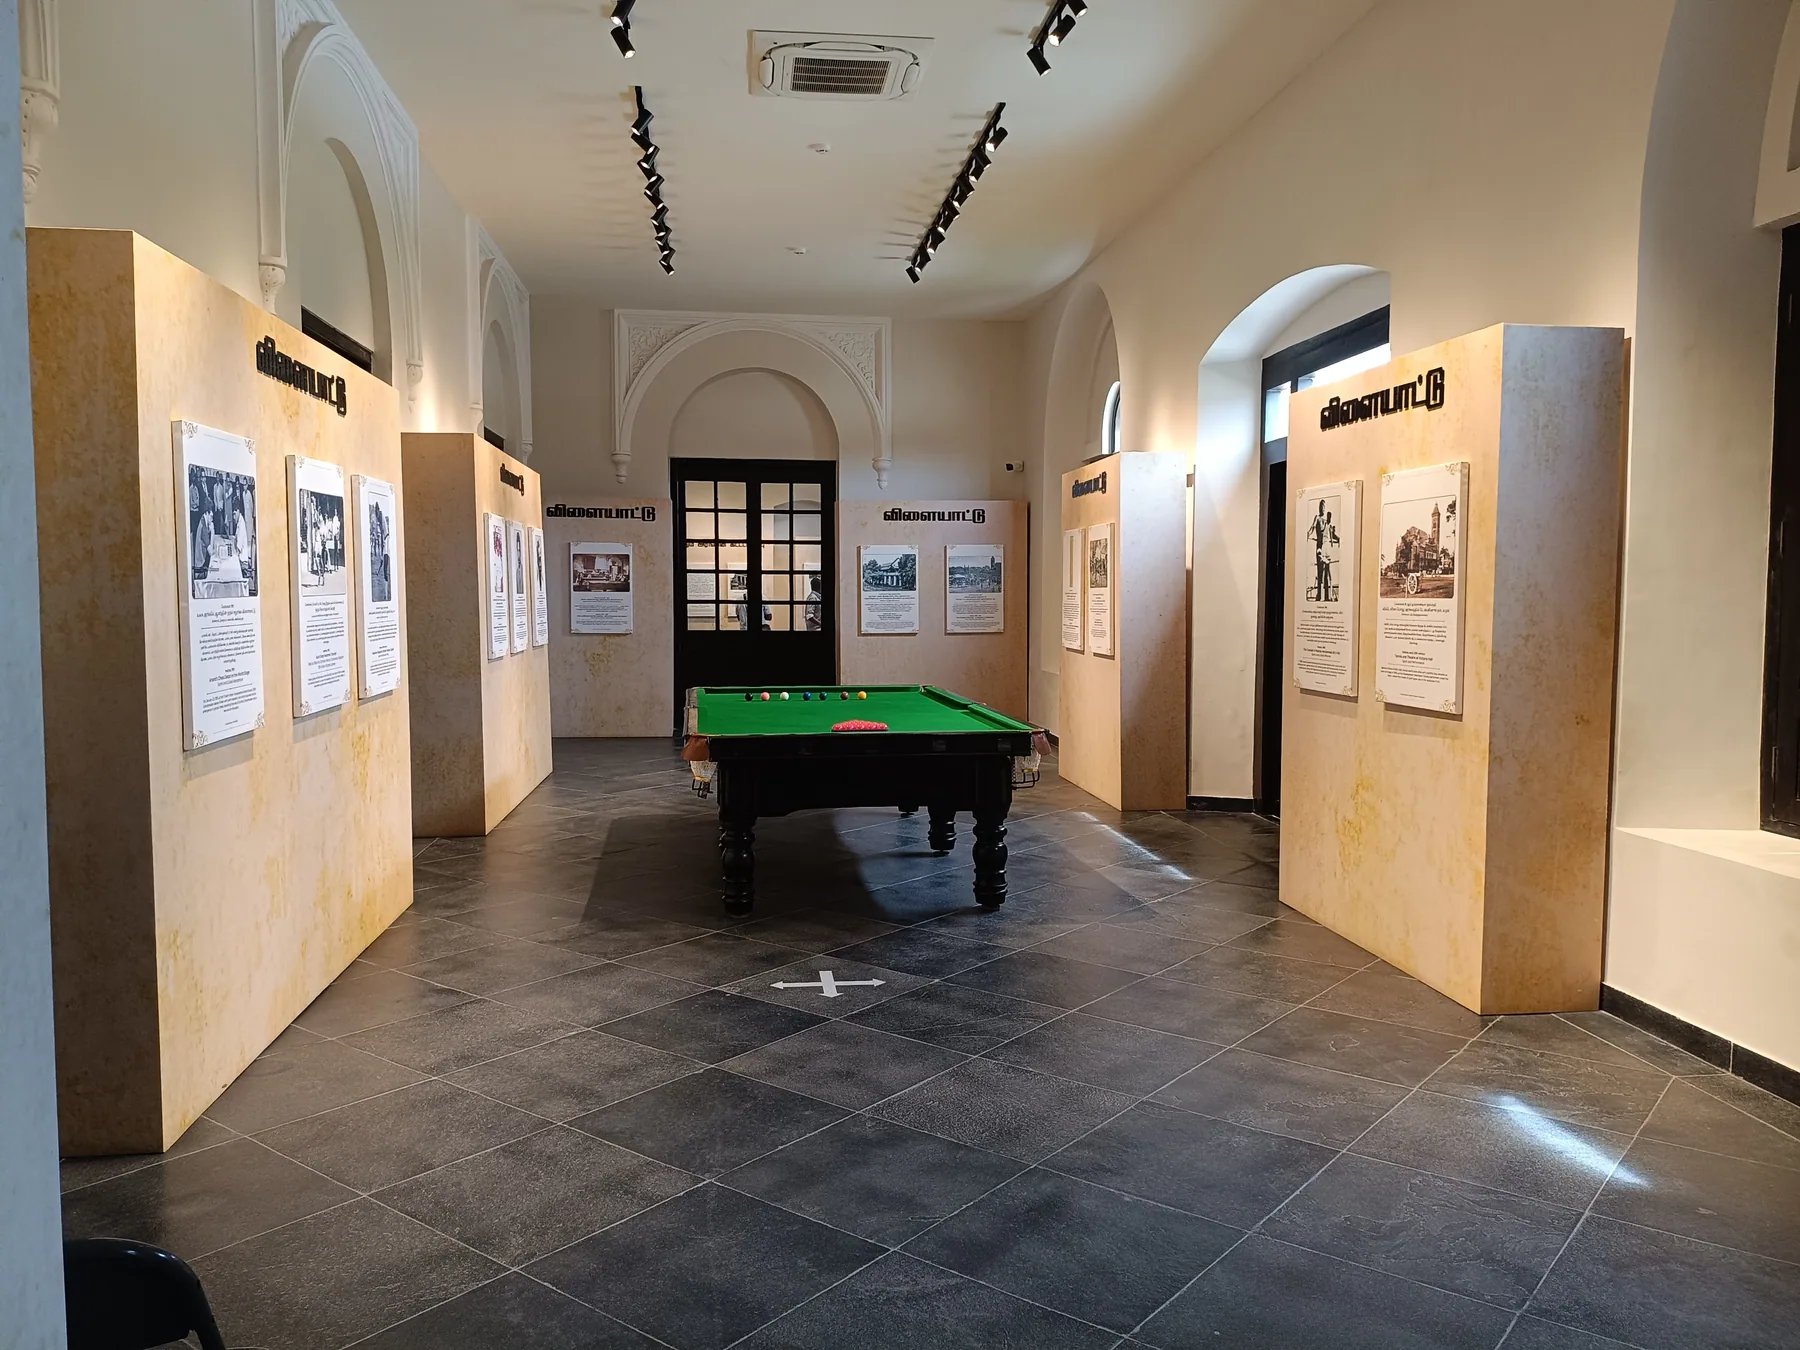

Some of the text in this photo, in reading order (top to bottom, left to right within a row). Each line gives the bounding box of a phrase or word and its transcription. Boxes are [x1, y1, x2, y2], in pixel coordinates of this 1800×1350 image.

[256, 335, 347, 417] விளையாட்டு
[1320, 366, 1445, 432] விளையாட்டு
[546, 503, 656, 522] விளையாட்டு
[883, 507, 986, 524] விளையாட்டு
